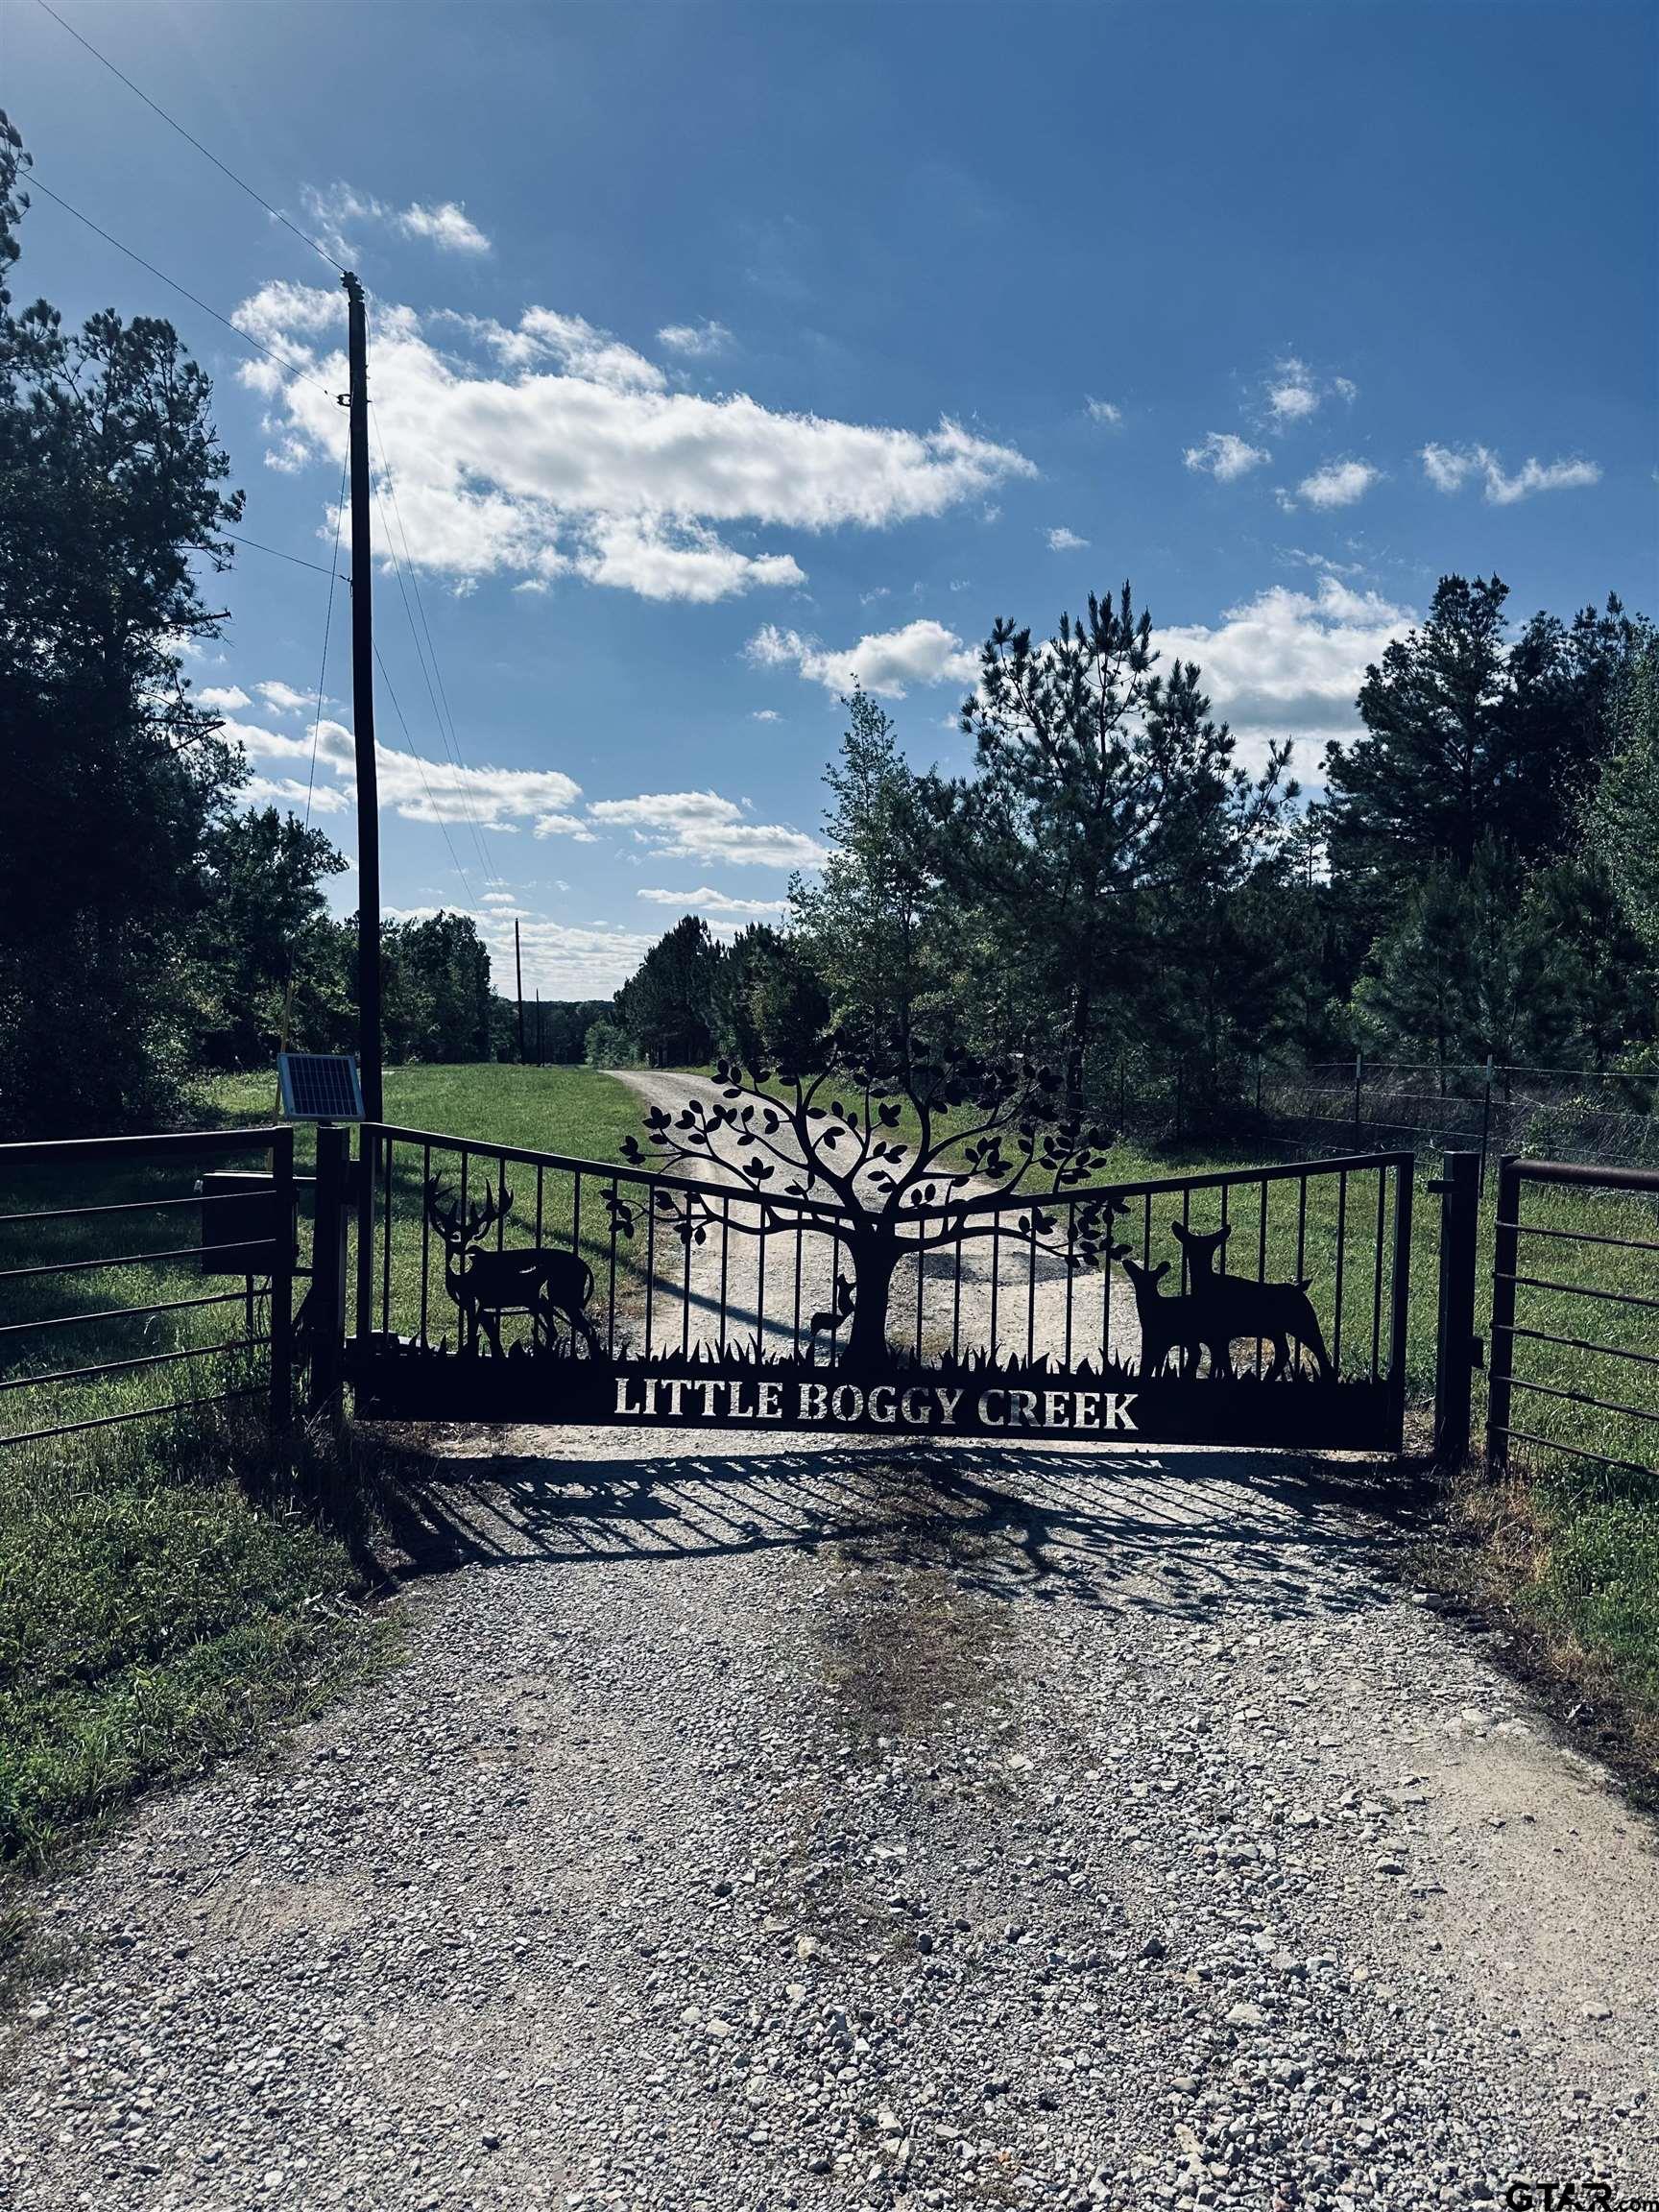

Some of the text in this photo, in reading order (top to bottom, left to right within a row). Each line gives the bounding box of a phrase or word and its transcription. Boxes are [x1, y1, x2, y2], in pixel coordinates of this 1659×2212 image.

[613, 1378, 1140, 1431] LITTLE BOGGY CREEK
